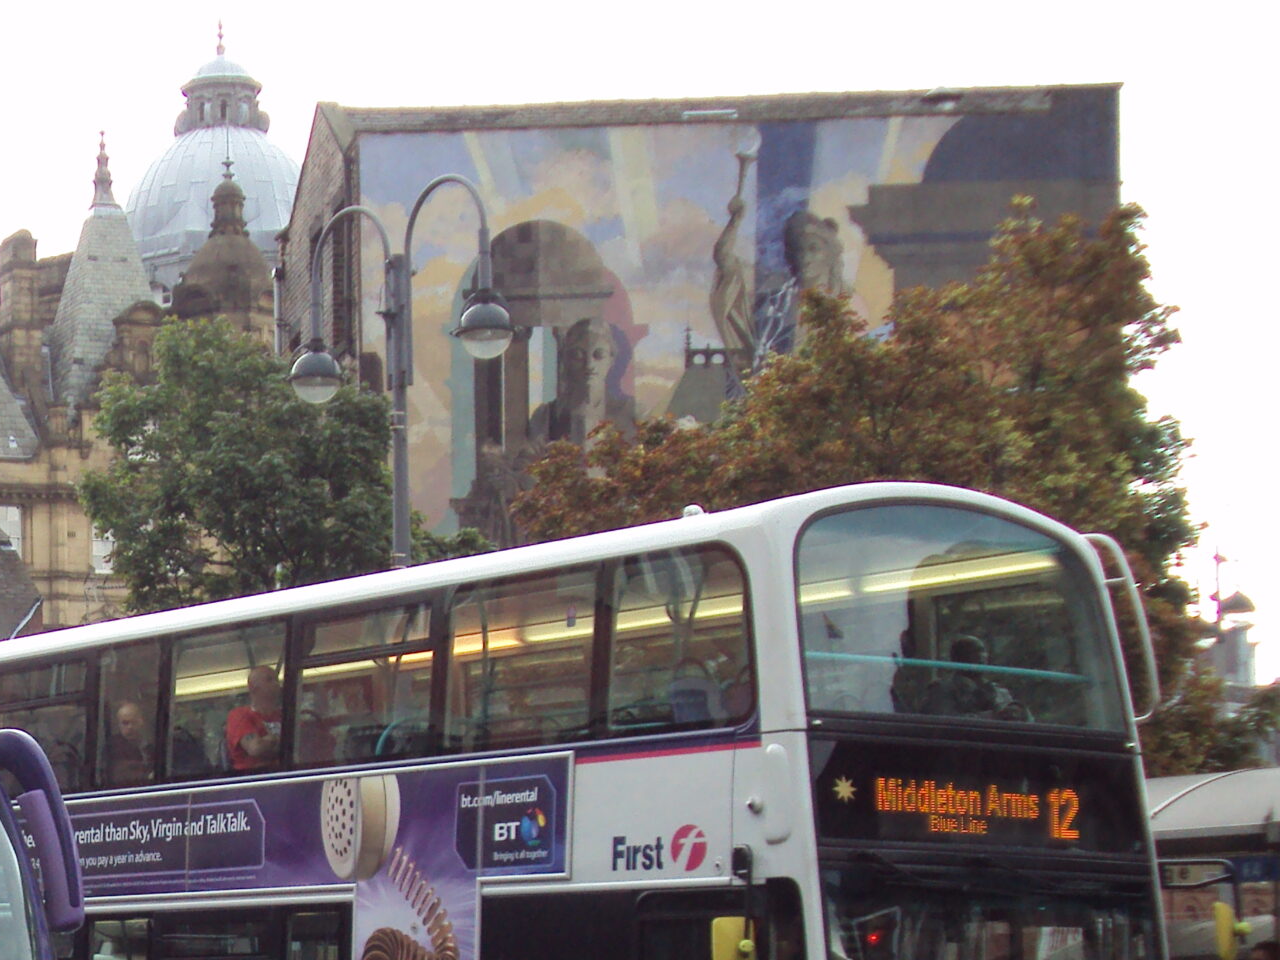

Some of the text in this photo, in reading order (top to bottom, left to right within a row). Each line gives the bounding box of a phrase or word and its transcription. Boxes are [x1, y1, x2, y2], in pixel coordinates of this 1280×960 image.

[461, 787, 538, 808] bt.com/linerental
[876, 778, 1080, 839] Middleton Arms 12
[75, 811, 251, 844] rental than Sky, Virgin and TalkTalk.
[494, 822, 520, 841] BT
[929, 814, 988, 834] Blue Line
[85, 855, 97, 869] you
[97, 856, 109, 868] pay
[108, 855, 113, 865] a
[113, 855, 127, 867] year
[127, 851, 134, 863] in
[135, 850, 163, 864] advance.
[612, 836, 664, 871] First
